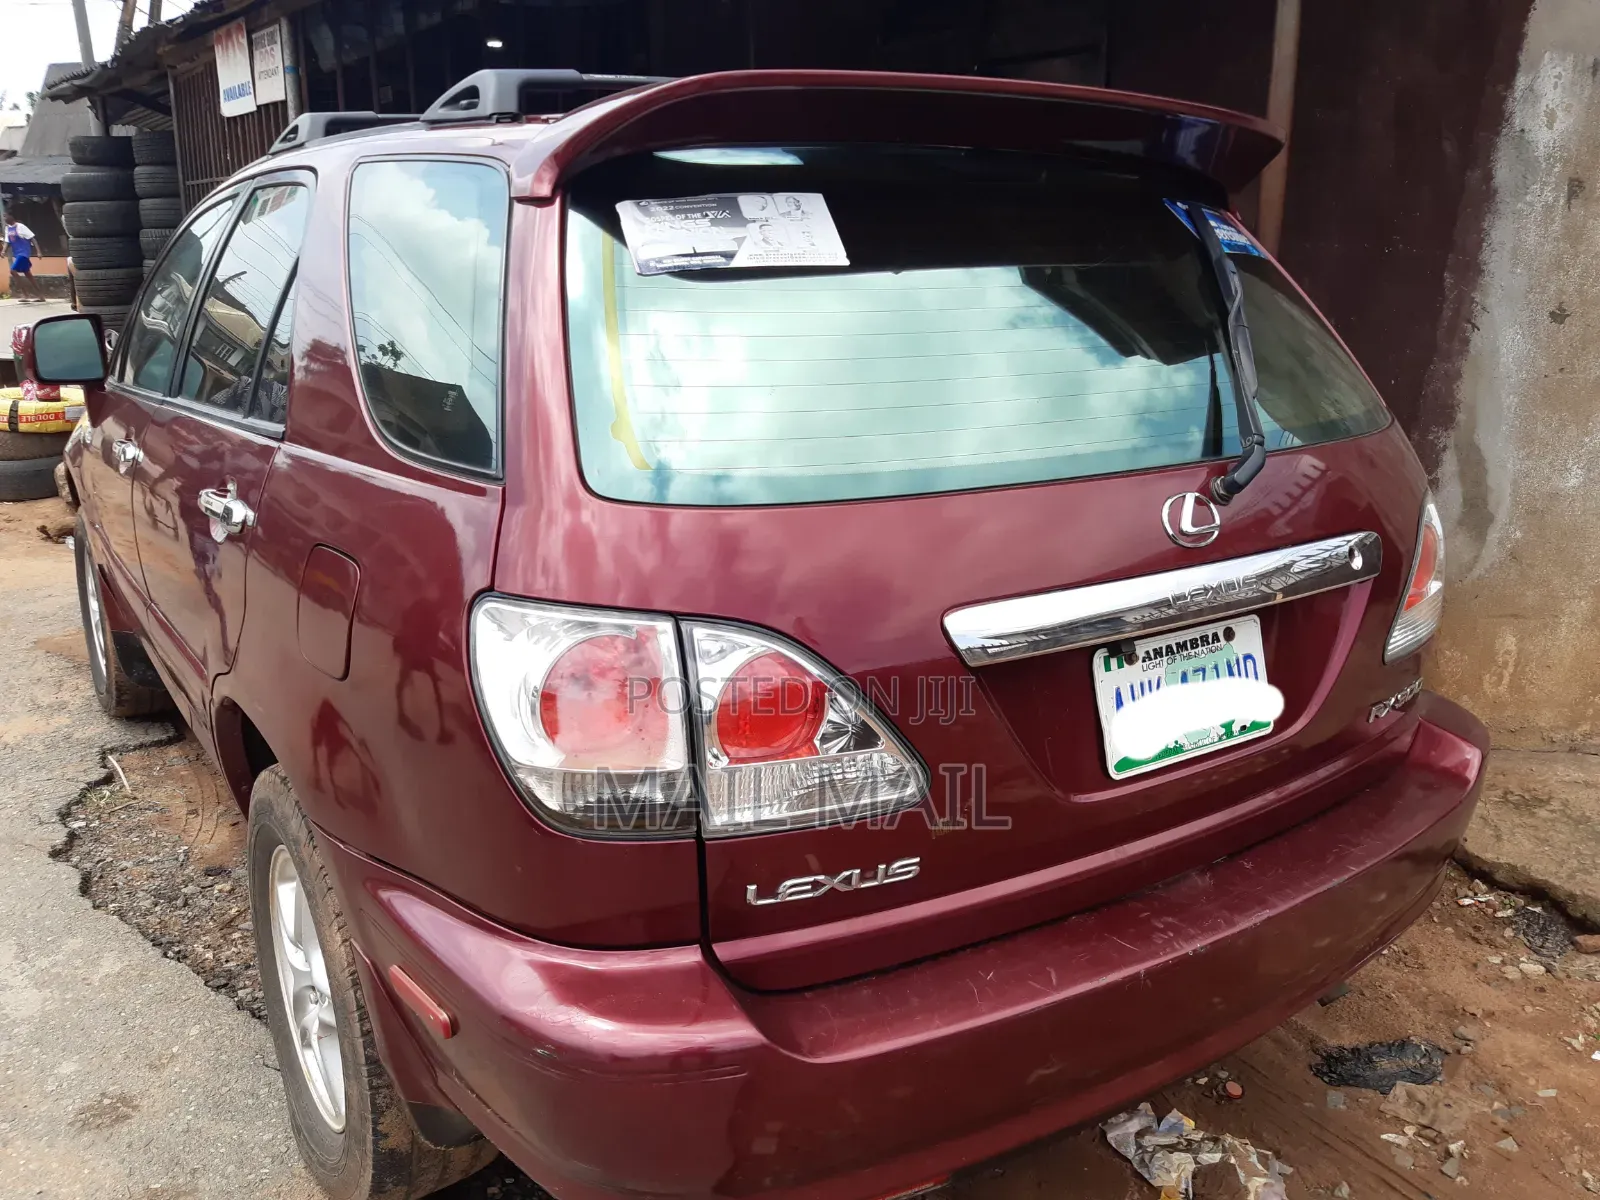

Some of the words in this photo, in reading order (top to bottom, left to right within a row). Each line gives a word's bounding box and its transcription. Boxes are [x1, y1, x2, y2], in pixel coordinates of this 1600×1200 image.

[223, 81, 252, 103] AVAILABLE
[21, 413, 55, 423] DOUBLE
[1169, 574, 1258, 605] LEXUS
[1142, 632, 1221, 662] ANAMBRA
[1142, 660, 1164, 672] LIGHT
[1166, 655, 1178, 666] OF
[1179, 651, 1192, 662] THE
[1194, 644, 1223, 659] NATION
[746, 855, 922, 907] LEXUS
